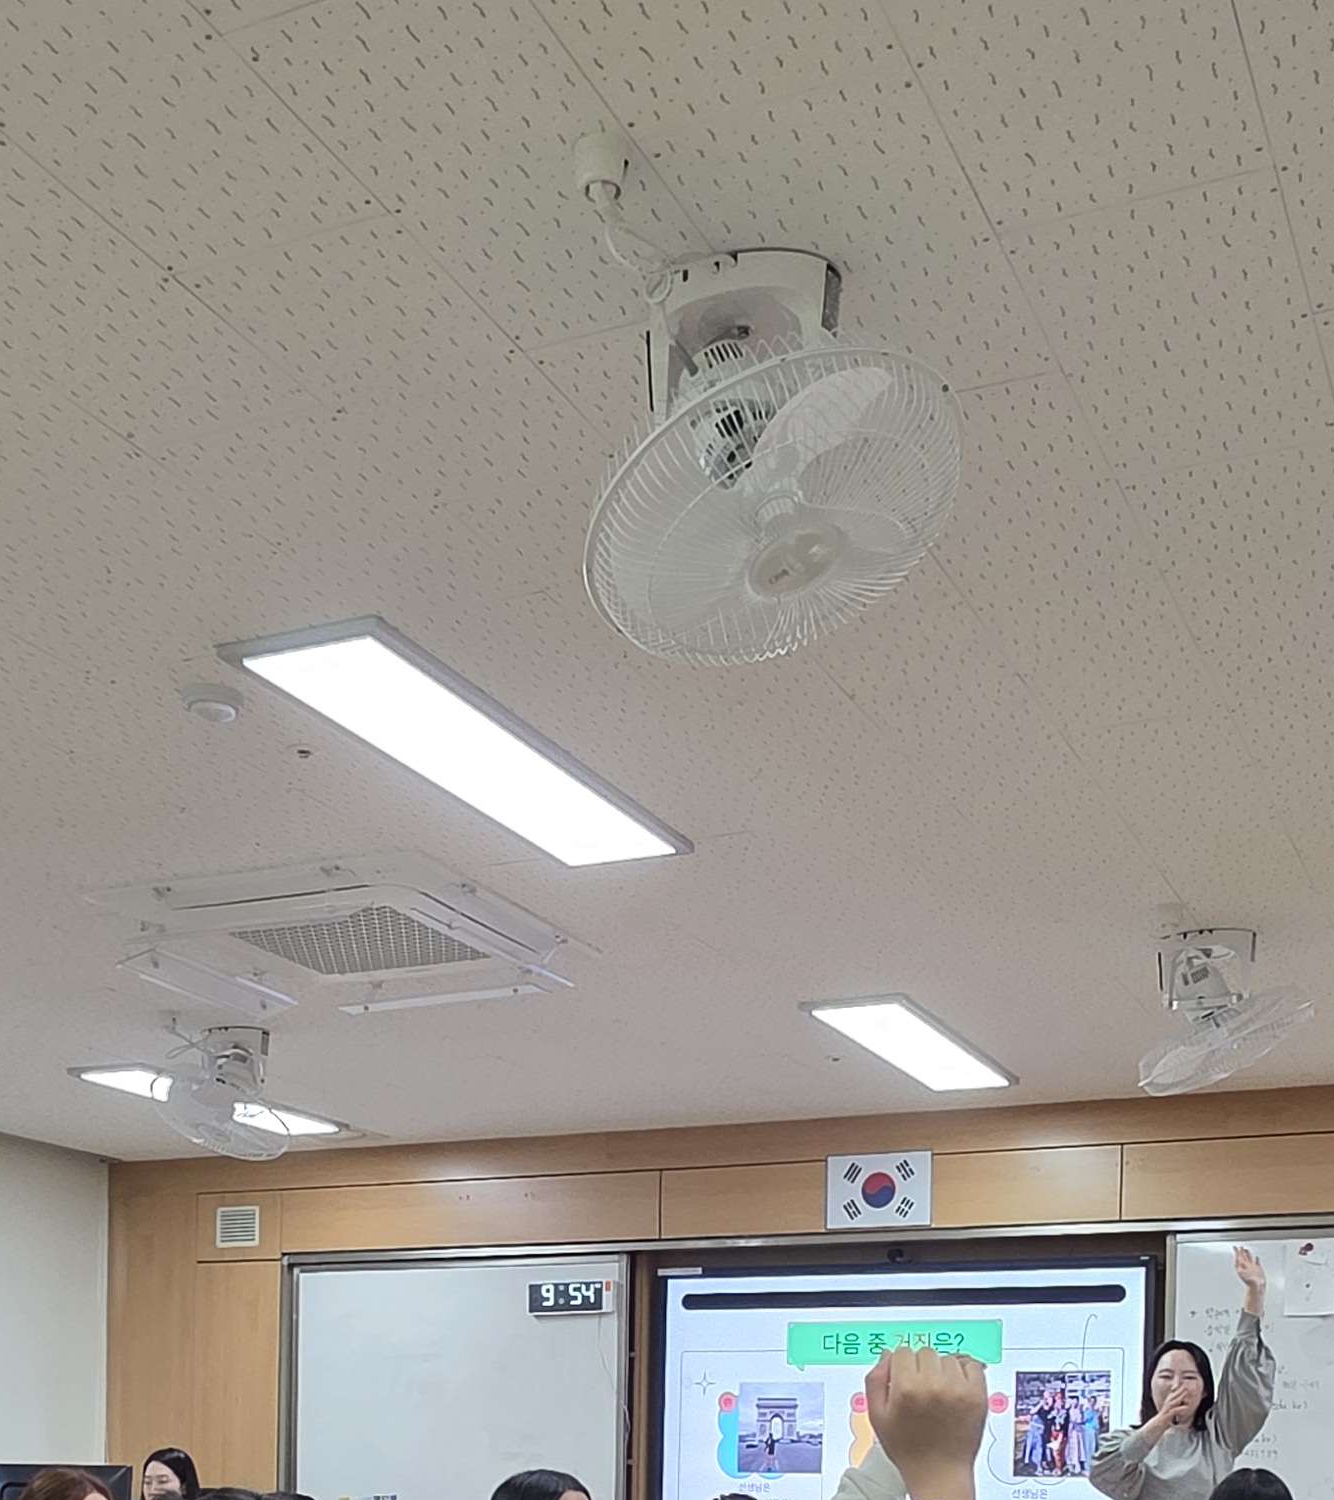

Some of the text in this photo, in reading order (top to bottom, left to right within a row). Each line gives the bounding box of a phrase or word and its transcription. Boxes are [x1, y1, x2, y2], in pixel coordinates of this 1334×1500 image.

[541, 1283, 595, 1307] 9:54
[823, 1332, 861, 1355] 다음
[867, 1332, 886, 1355] 중
[1012, 1488, 1048, 1499] 선생님은
